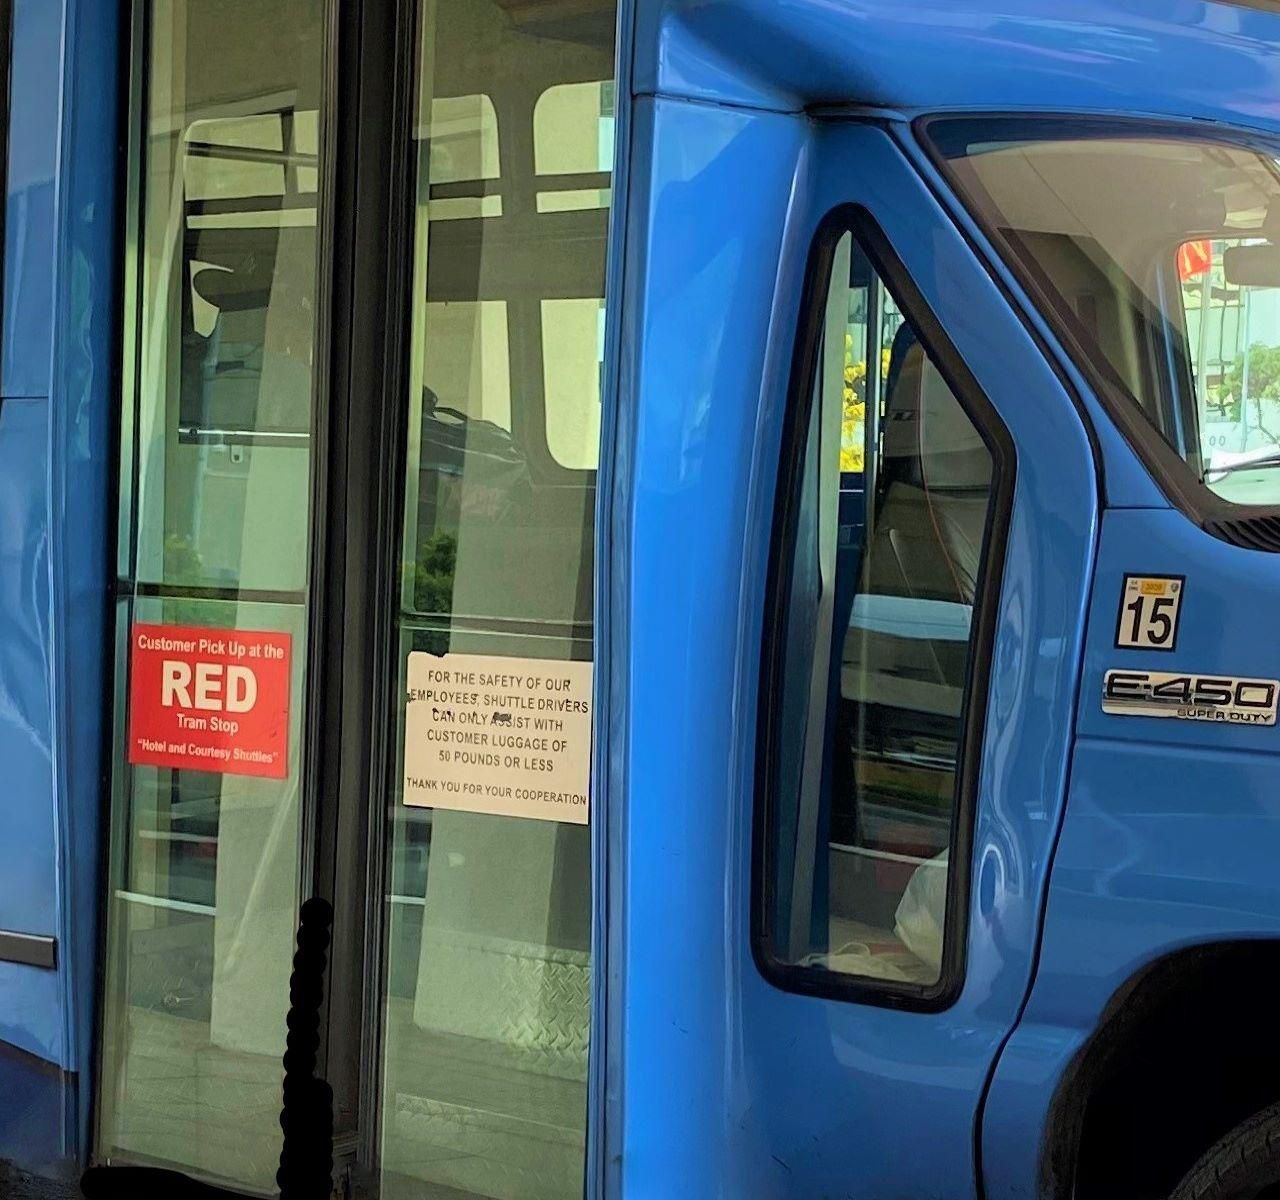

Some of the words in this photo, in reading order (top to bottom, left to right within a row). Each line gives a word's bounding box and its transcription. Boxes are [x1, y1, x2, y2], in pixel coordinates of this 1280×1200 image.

[1127, 596, 1174, 644] 15
[138, 634, 196, 652] Customer
[199, 638, 225, 655] Pick
[228, 641, 245, 660] Up
[249, 644, 261, 657] at
[264, 644, 284, 659] the
[161, 660, 258, 713] RED
[428, 670, 450, 684] FOR
[454, 672, 475, 685] THE
[479, 673, 523, 688] SAFETY
[526, 677, 541, 690] OF
[545, 679, 570, 692] OUR
[1106, 673, 1275, 708] E-450
[483, 694, 534, 710] SHUTTLE
[538, 699, 589, 714] DRIVERS
[1177, 708, 1225, 720] SUPER
[1229, 712, 1274, 723] DUTY
[176, 713, 206, 730] Tram
[210, 716, 238, 735] Stop
[432, 708, 455, 723] CAN
[458, 711, 489, 725] ONLY
[534, 718, 563, 731] WITH
[427, 728, 488, 745] CUSTOMER
[492, 735, 548, 751] LUGGAGE
[551, 740, 567, 752] OF
[168, 743, 186, 755] and
[188, 744, 231, 761] Courtesy
[439, 750, 451, 762] 50
[454, 751, 500, 767] POUNDS
[504, 755, 520, 768] OR
[524, 758, 554, 772] LESS
[407, 777, 438, 790] THANK
[440, 780, 460, 793] YOU
[463, 783, 483, 795] FOR
[485, 785, 512, 798] YOUR
[515, 788, 587, 806] COOPERATION
